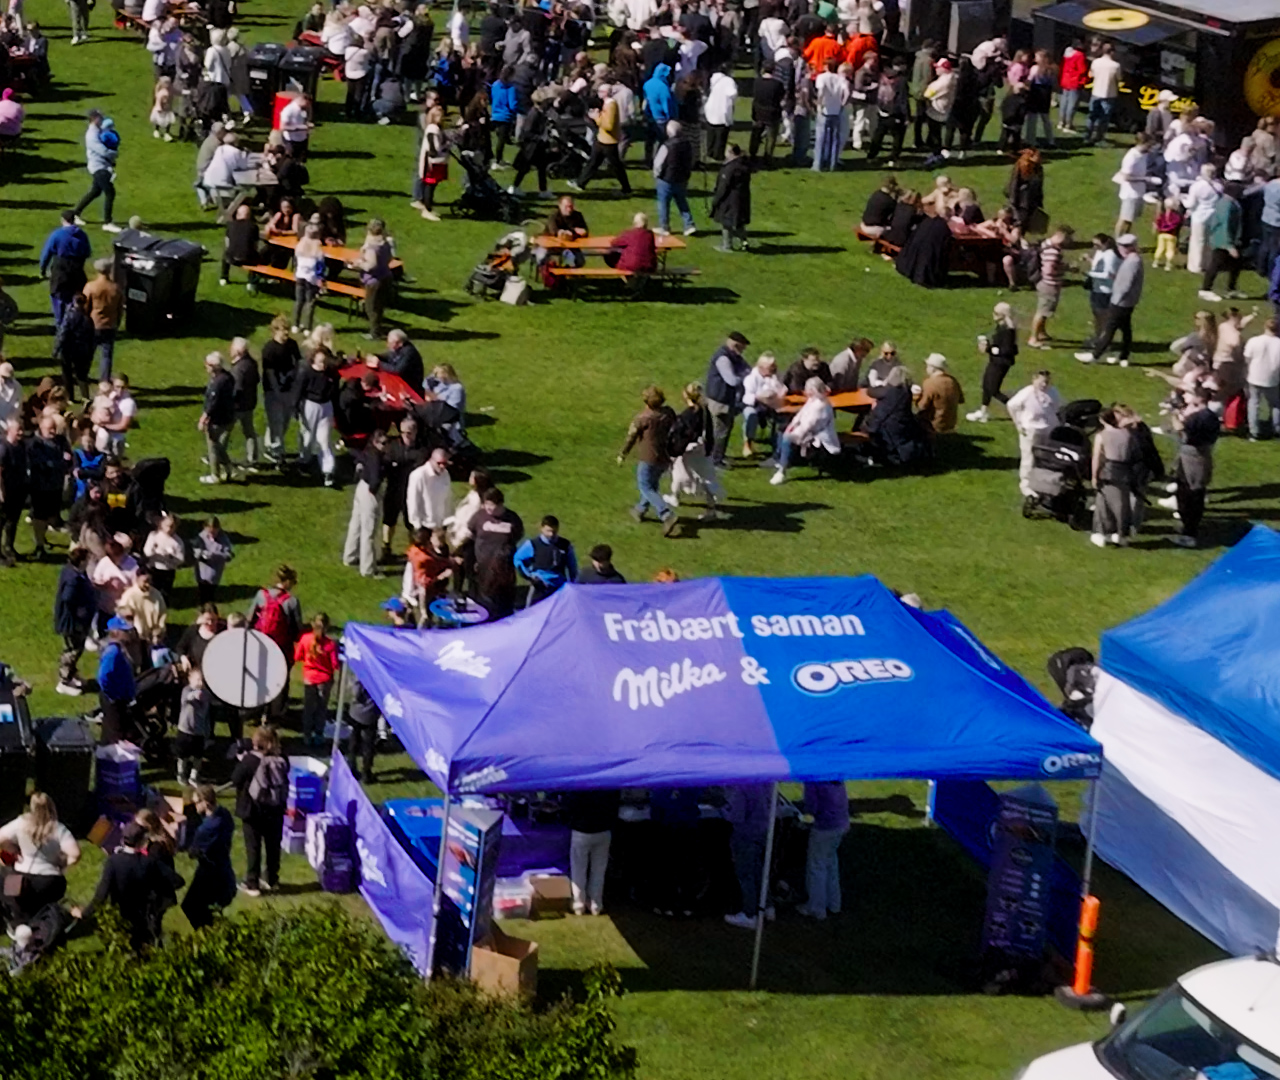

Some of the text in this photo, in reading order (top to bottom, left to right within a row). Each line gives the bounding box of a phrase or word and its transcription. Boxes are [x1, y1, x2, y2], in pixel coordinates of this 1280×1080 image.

[603, 610, 866, 642] Frábært saman
[612, 656, 914, 711] Milka & OREO
